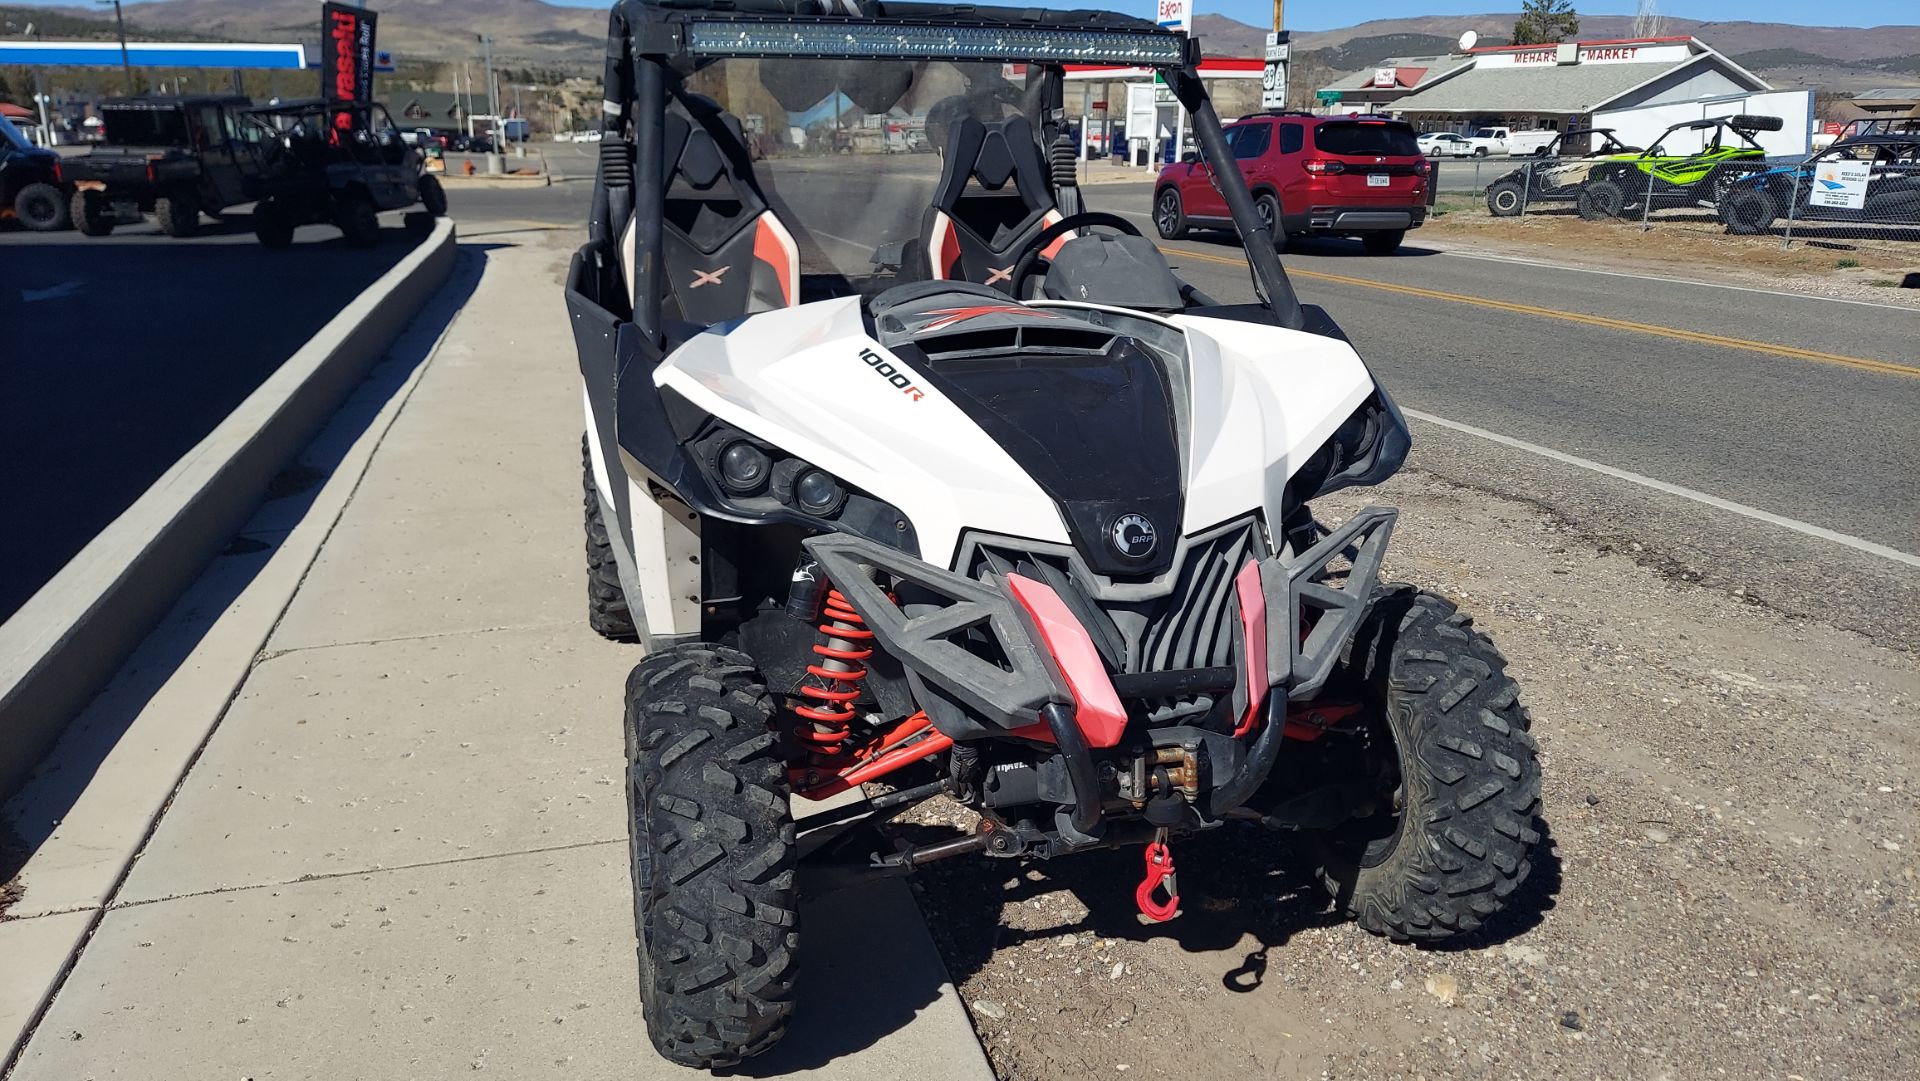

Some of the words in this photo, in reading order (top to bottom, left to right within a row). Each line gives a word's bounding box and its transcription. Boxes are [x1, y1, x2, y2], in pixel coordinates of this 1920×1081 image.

[1160, 0, 1183, 19] Exxon
[1514, 51, 1557, 63] MEHAR'S
[1586, 47, 1638, 60] MARKET
[1264, 67, 1274, 84] 89
[858, 347, 925, 402] 1000R
[1131, 535, 1153, 544] BRP
